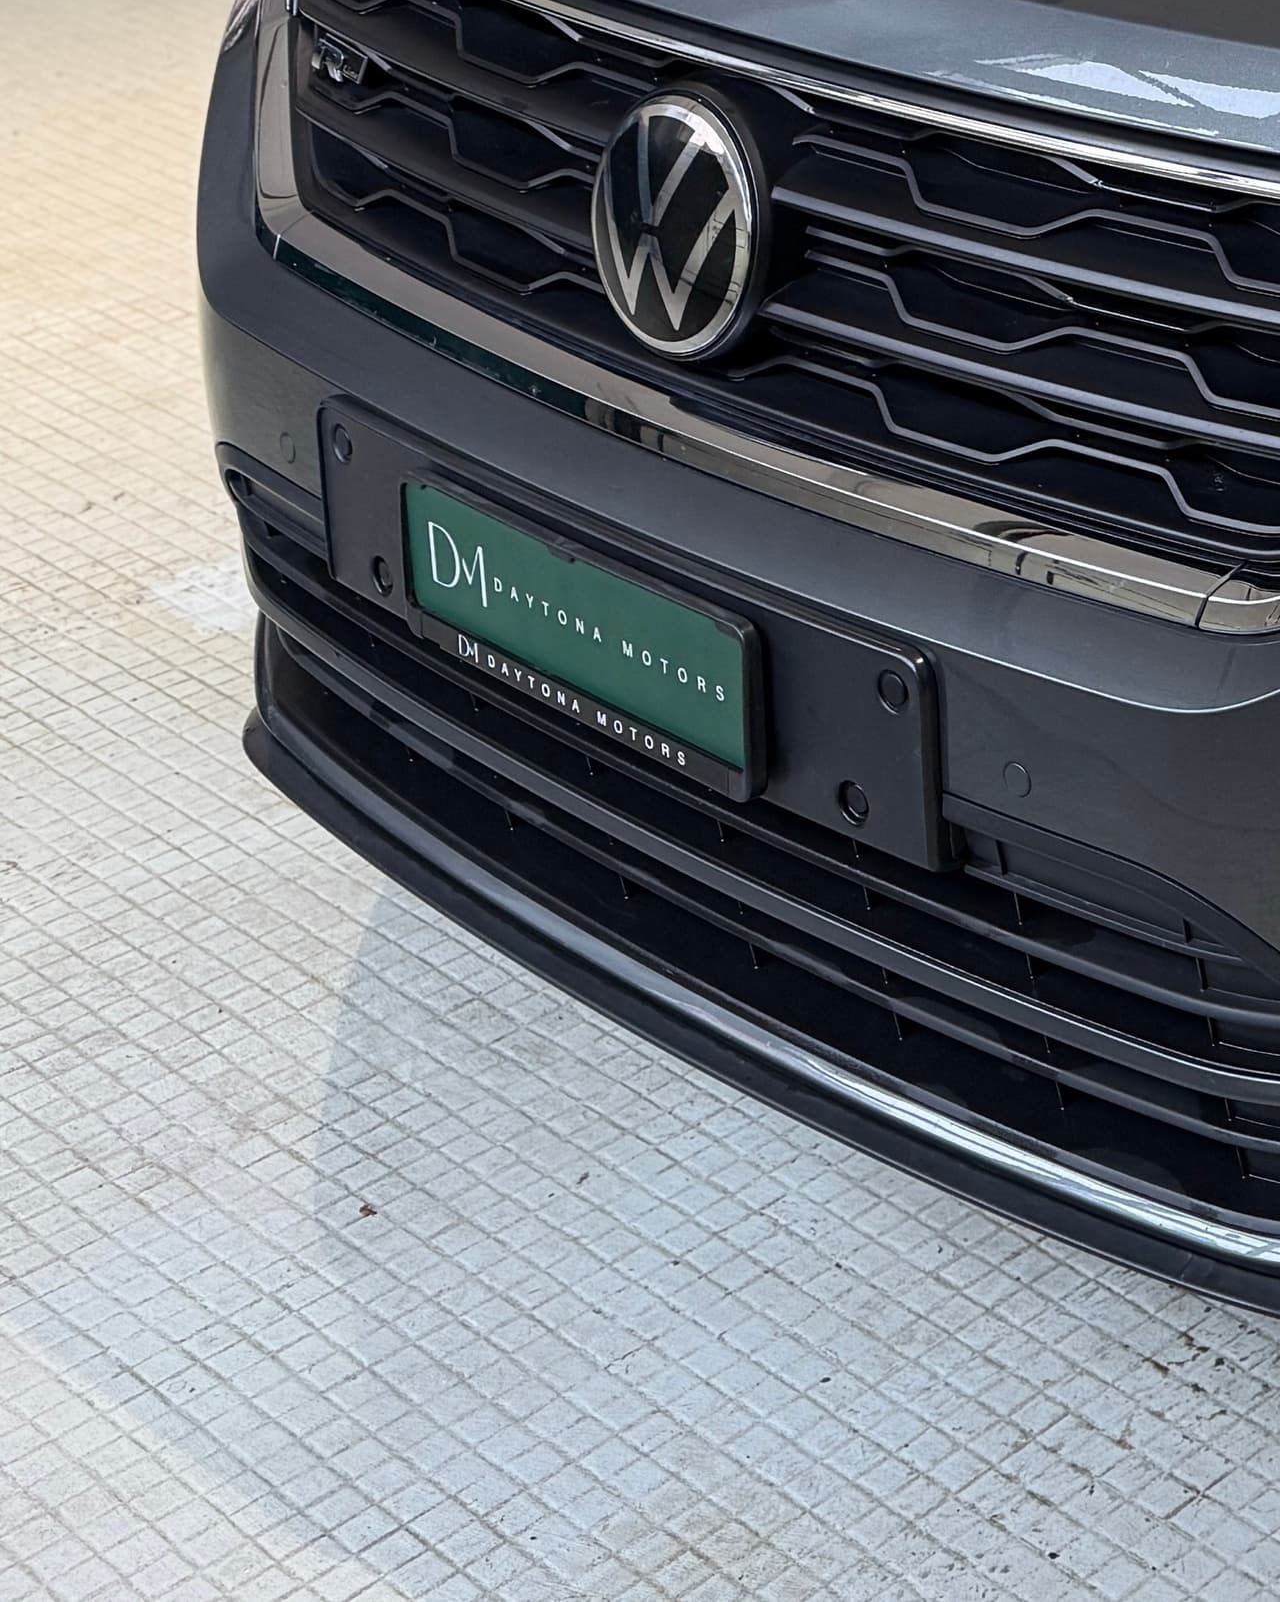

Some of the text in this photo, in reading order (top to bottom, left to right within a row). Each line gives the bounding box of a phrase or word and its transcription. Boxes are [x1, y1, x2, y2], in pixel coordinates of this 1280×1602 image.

[493, 576, 603, 643] DAYTONA
[621, 639, 726, 703] MOTORS
[487, 653, 581, 714] DAYTONA
[596, 709, 687, 767] MOTORS
